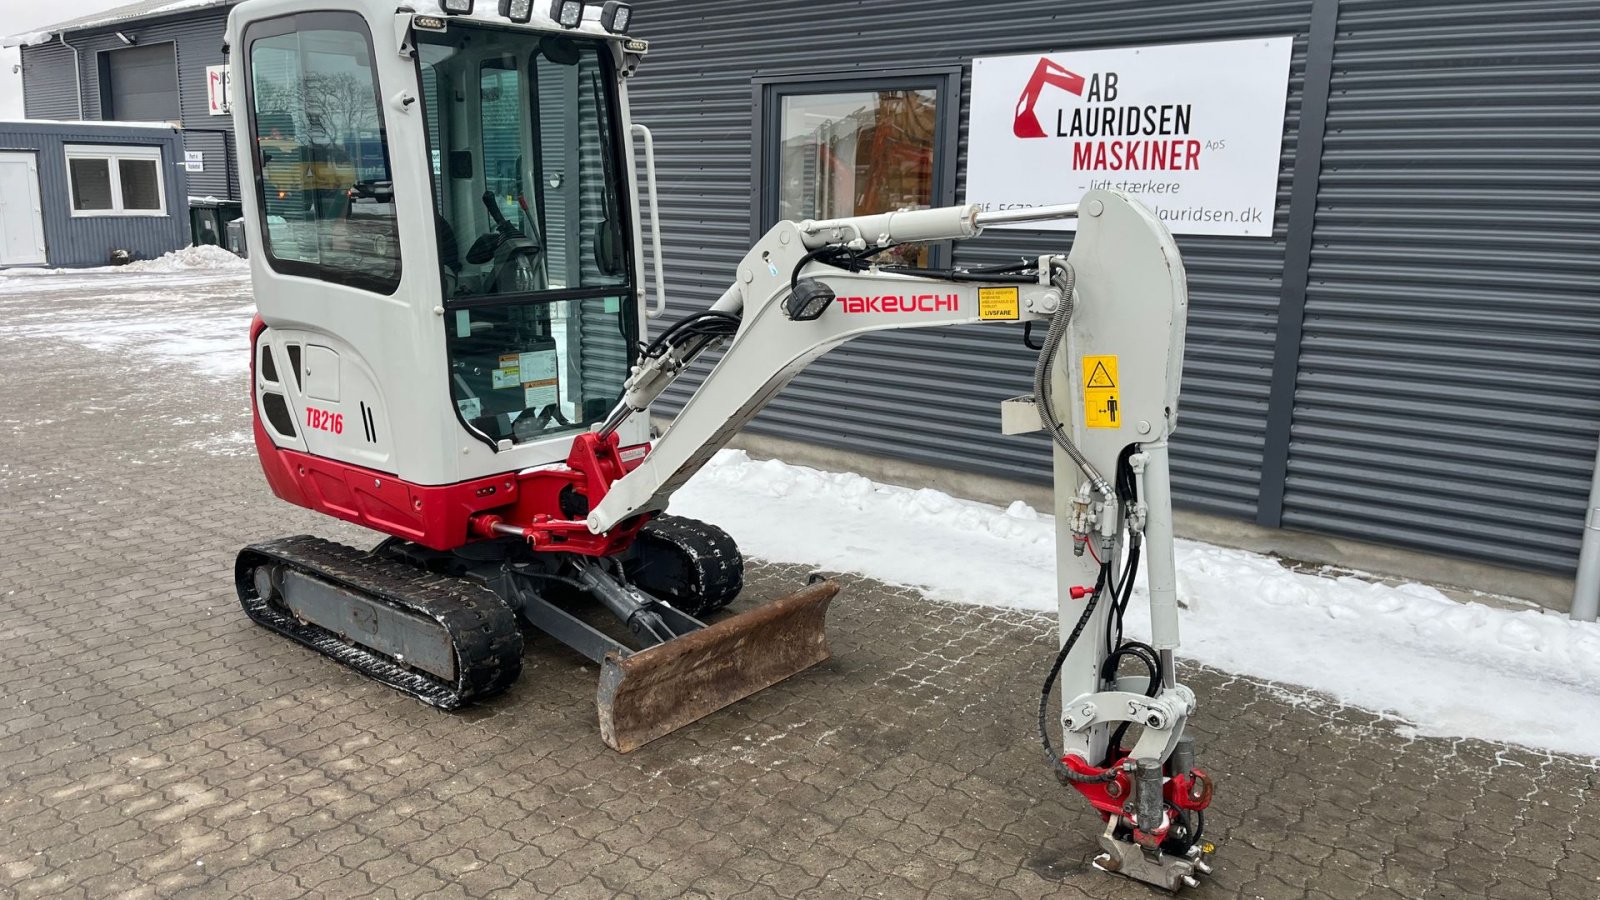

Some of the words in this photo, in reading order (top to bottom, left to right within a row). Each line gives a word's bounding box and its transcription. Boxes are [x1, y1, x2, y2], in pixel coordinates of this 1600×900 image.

[1087, 72, 1118, 102] AB
[1056, 104, 1191, 137] LAURIDSEN
[1072, 140, 1201, 171] MASKINER
[1205, 139, 1226, 151] ApS
[1115, 180, 1180, 193] stærkere
[836, 294, 958, 313] TAKEUCHI
[306, 407, 343, 434] TB216
